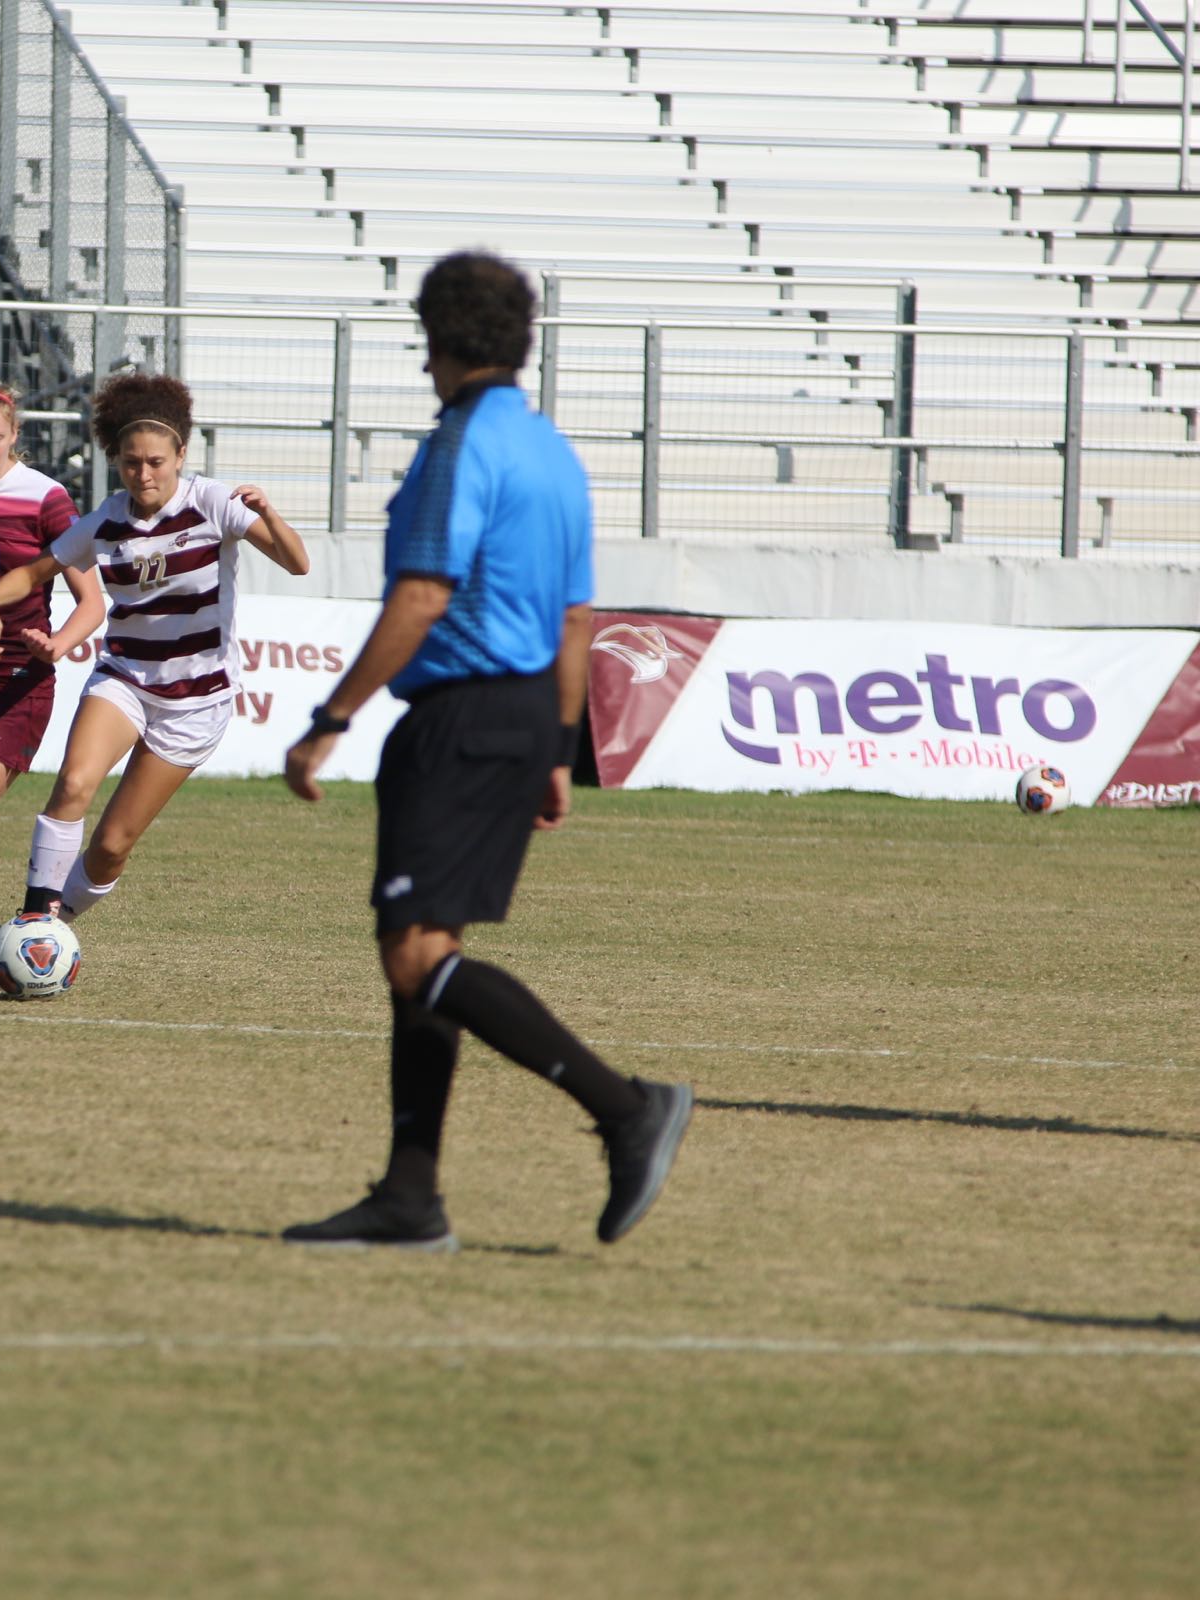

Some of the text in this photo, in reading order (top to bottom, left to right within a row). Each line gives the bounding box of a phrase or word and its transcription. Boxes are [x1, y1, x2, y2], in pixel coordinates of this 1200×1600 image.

[133, 552, 170, 592] 22
[239, 639, 343, 673] ynes
[235, 691, 273, 725] ly
[724, 653, 1096, 743] metro
[794, 742, 835, 775] by
[1106, 781, 1200, 804] #DUST
